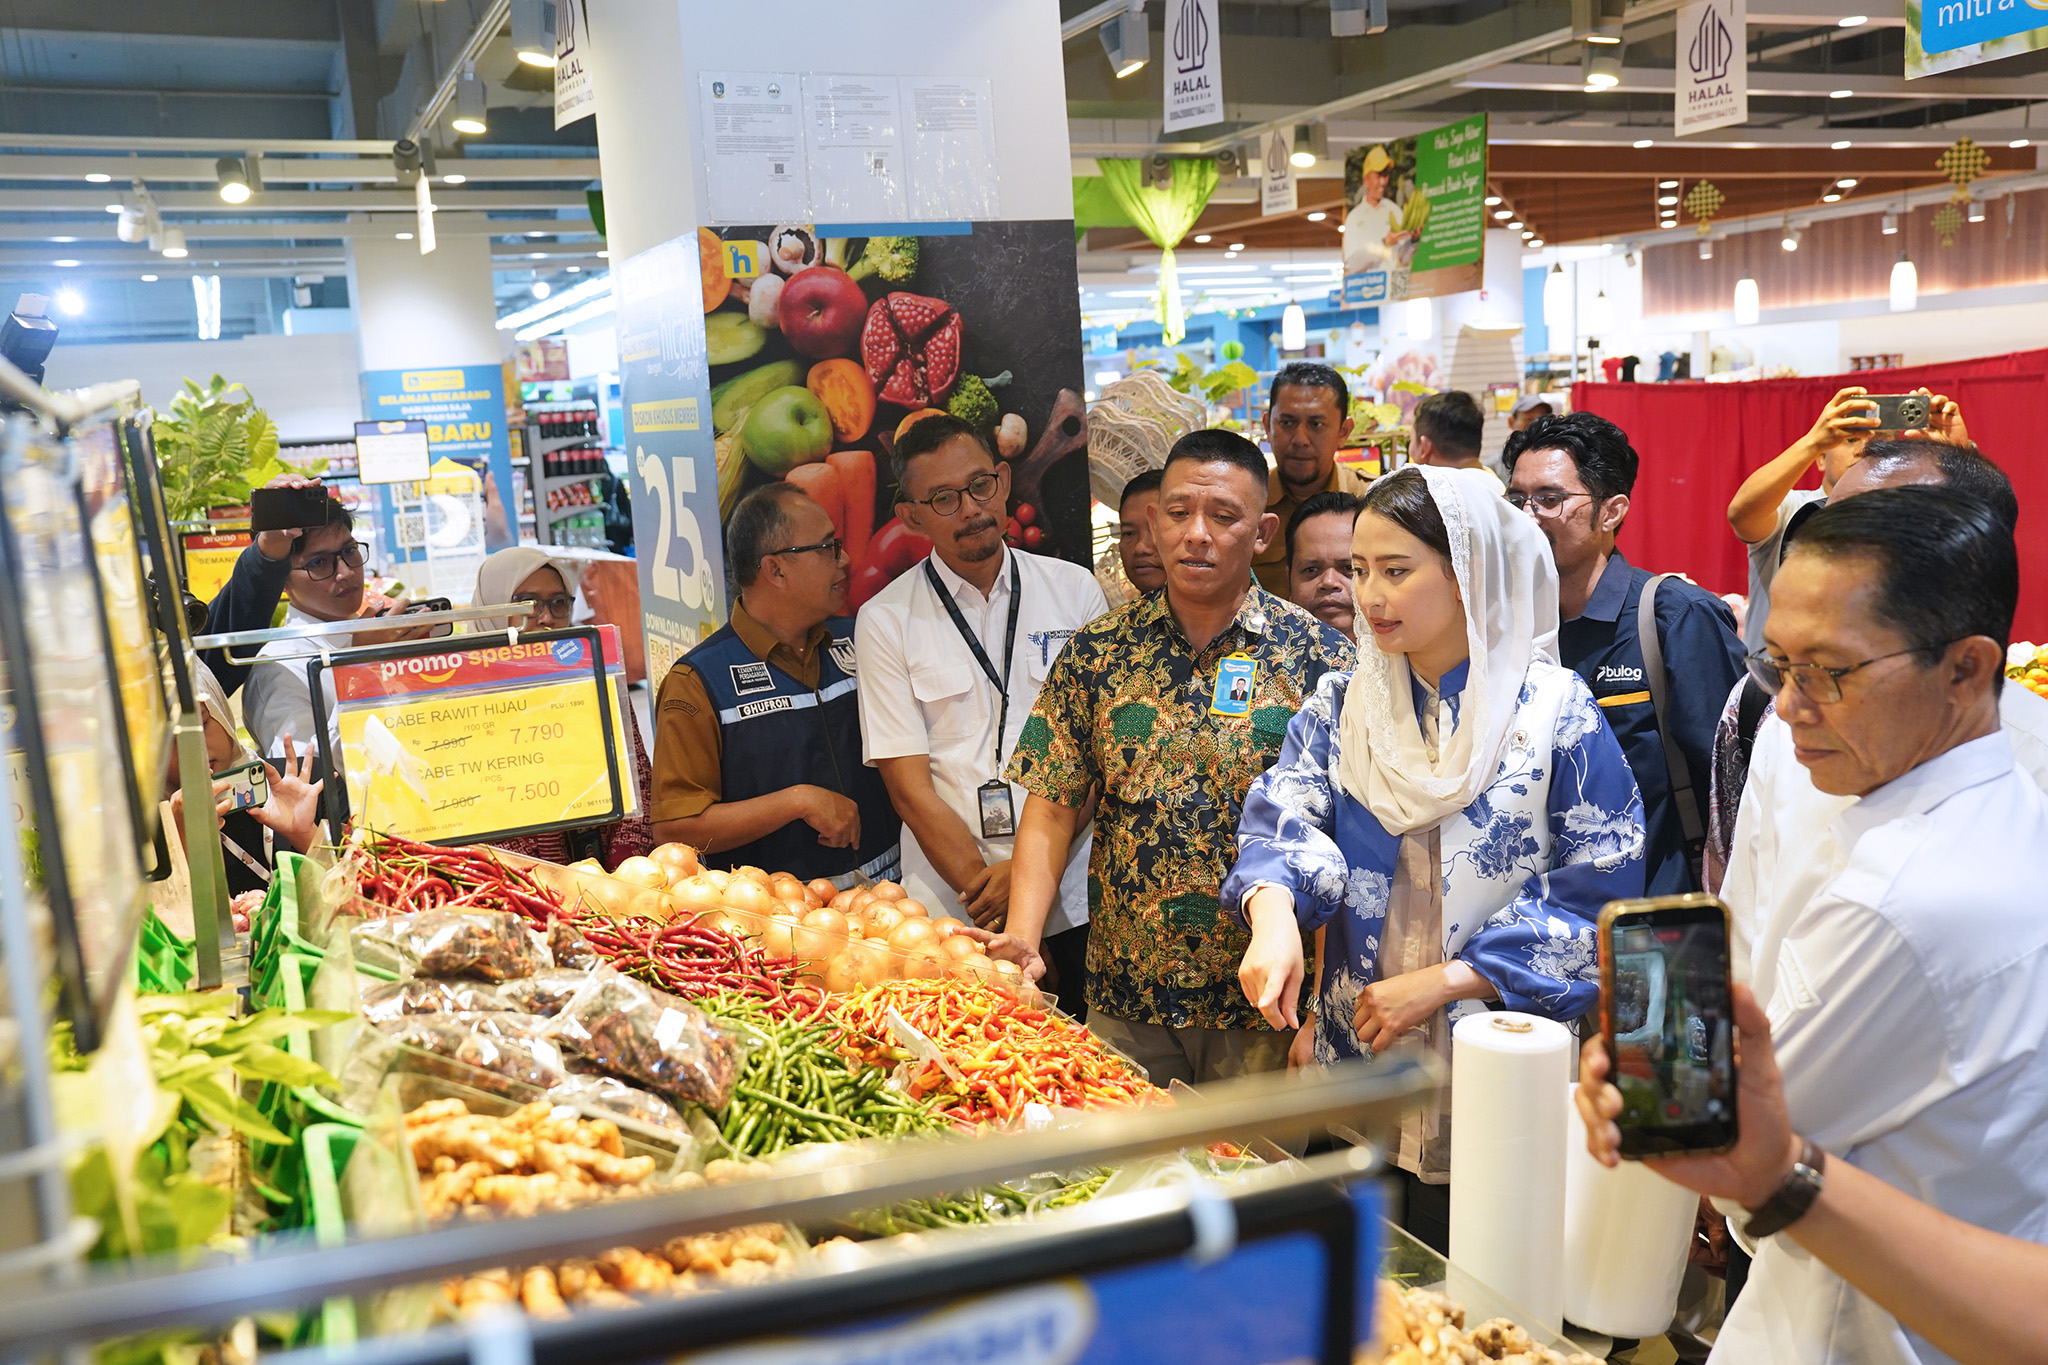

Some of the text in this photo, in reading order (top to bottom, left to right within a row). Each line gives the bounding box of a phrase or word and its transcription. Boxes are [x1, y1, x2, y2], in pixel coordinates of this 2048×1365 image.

[558, 58, 583, 86] HALAL
[1174, 75, 1210, 96] HALAL
[1688, 83, 1733, 103] HALAL
[1173, 92, 1211, 105] INDONESIA
[1688, 98, 1733, 111] INDONESIA
[378, 390, 491, 405] BELANJA SEKARANG
[633, 406, 697, 427] DISKON KHUSUS MEMBER
[427, 422, 491, 442] BARU
[203, 533, 236, 544] promo
[645, 453, 704, 610] 25
[645, 612, 696, 646] DOWNLOAD NOW
[556, 640, 576, 656] paling
[559, 645, 579, 660] hemat
[381, 640, 553, 681] promo spesial
[1605, 664, 1642, 681] bulog
[383, 699, 528, 729] CABE RAWIT HIJAU
[743, 698, 790, 715] GHUFRON
[463, 721, 496, 732] /100 GR
[510, 722, 565, 745] 7.790
[412, 737, 466, 751] Rp 7.990
[459, 760, 483, 774] TW
[486, 752, 545, 770] KERING
[484, 774, 503, 783] PCS
[505, 780, 561, 803] 7.500
